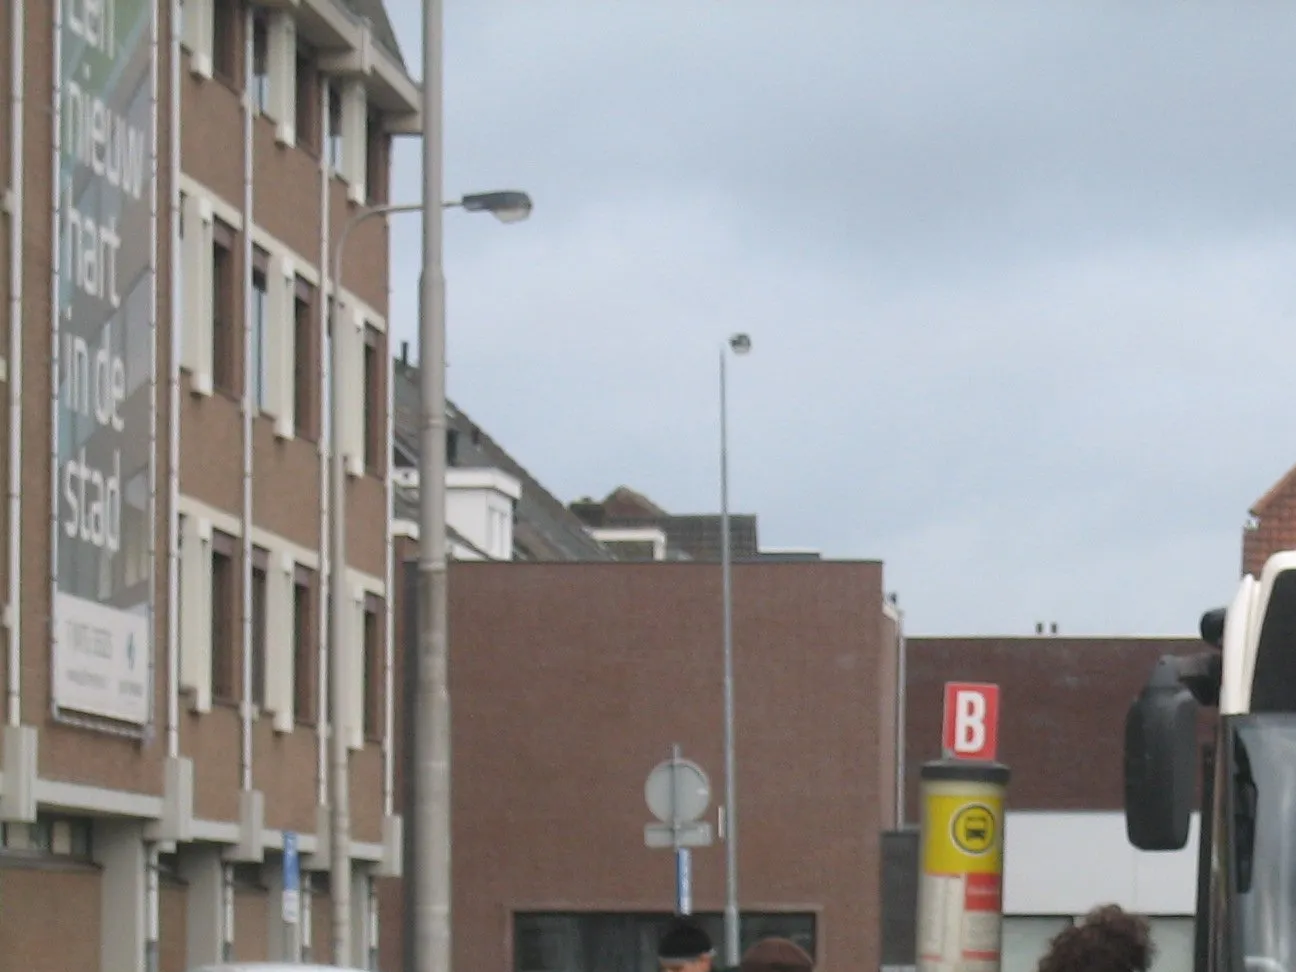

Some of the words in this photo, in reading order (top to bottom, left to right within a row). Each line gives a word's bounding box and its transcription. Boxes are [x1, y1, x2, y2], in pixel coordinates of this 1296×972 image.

[67, 62, 144, 199] nieuw
[66, 172, 121, 309] hart
[66, 304, 88, 416] in
[95, 322, 125, 432] de
[64, 446, 120, 552] stad
[953, 690, 986, 753] B
